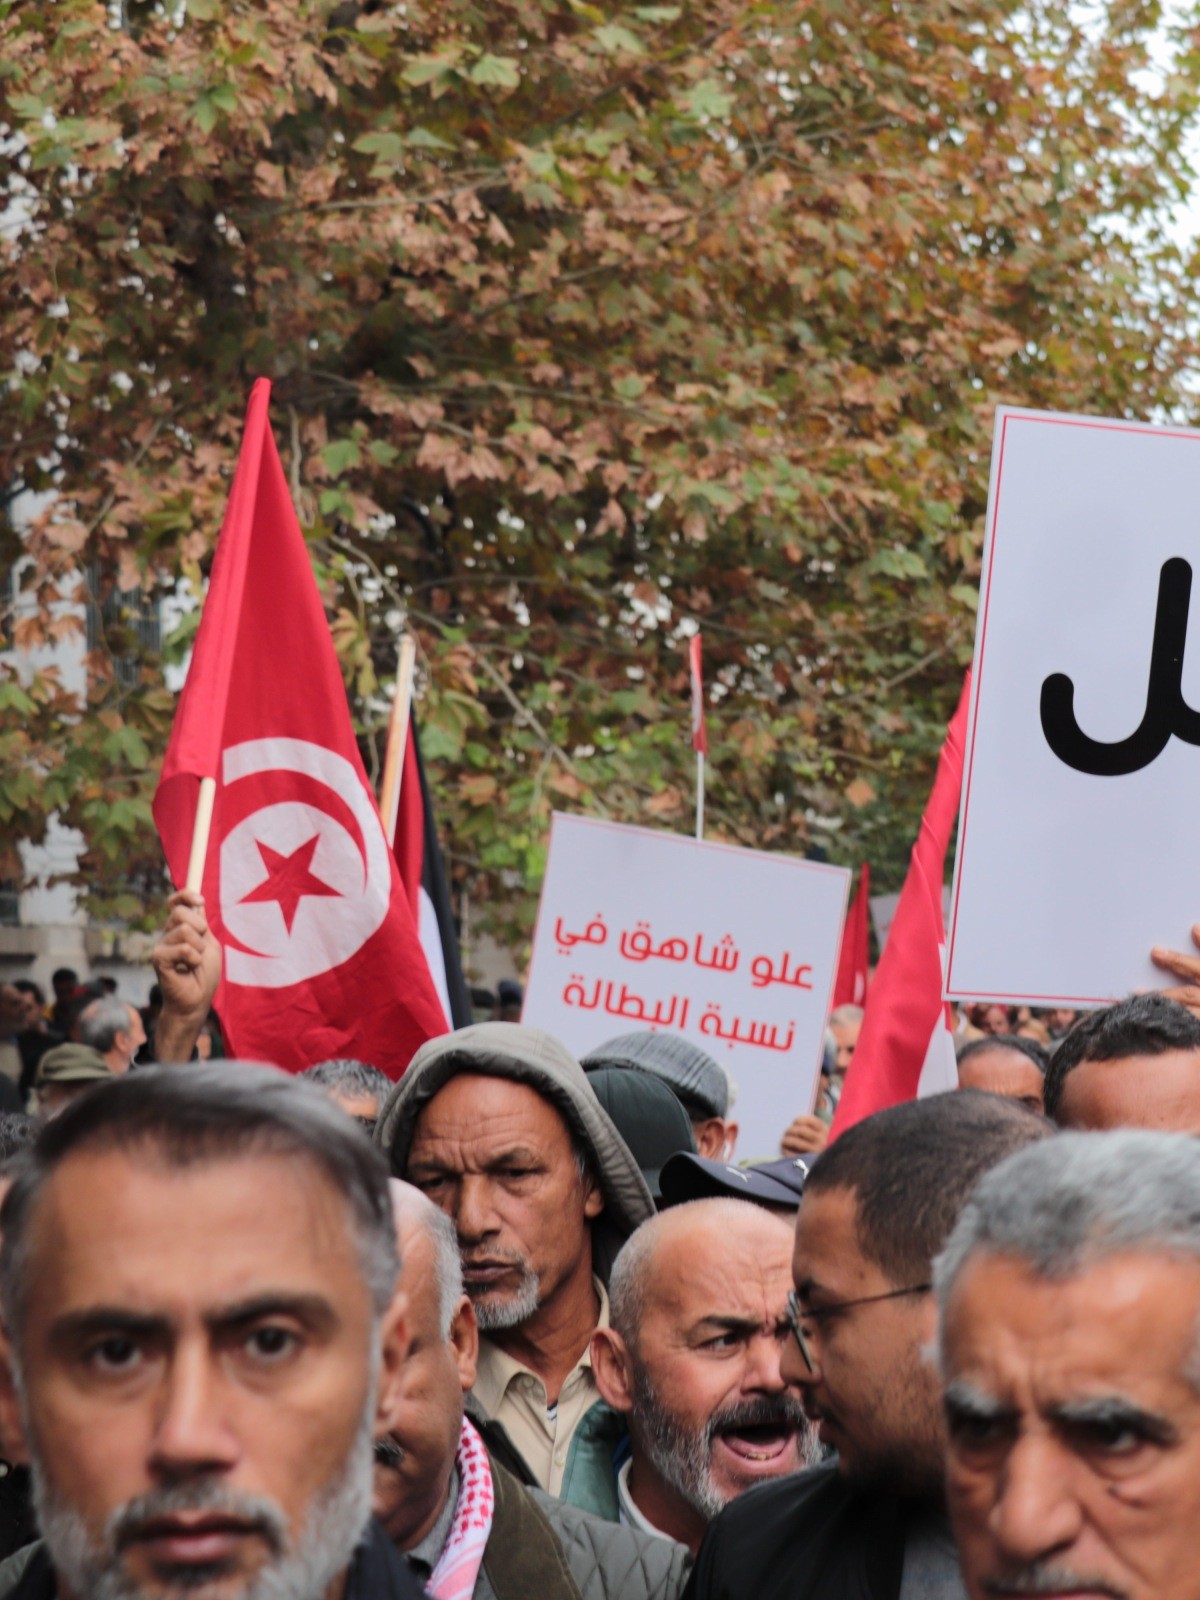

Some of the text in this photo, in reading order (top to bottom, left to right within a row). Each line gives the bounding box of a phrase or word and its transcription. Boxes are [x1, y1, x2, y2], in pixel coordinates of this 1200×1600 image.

[554, 913, 813, 990] علو شاهق في
[562, 973, 796, 1052] نسبة البطالة
